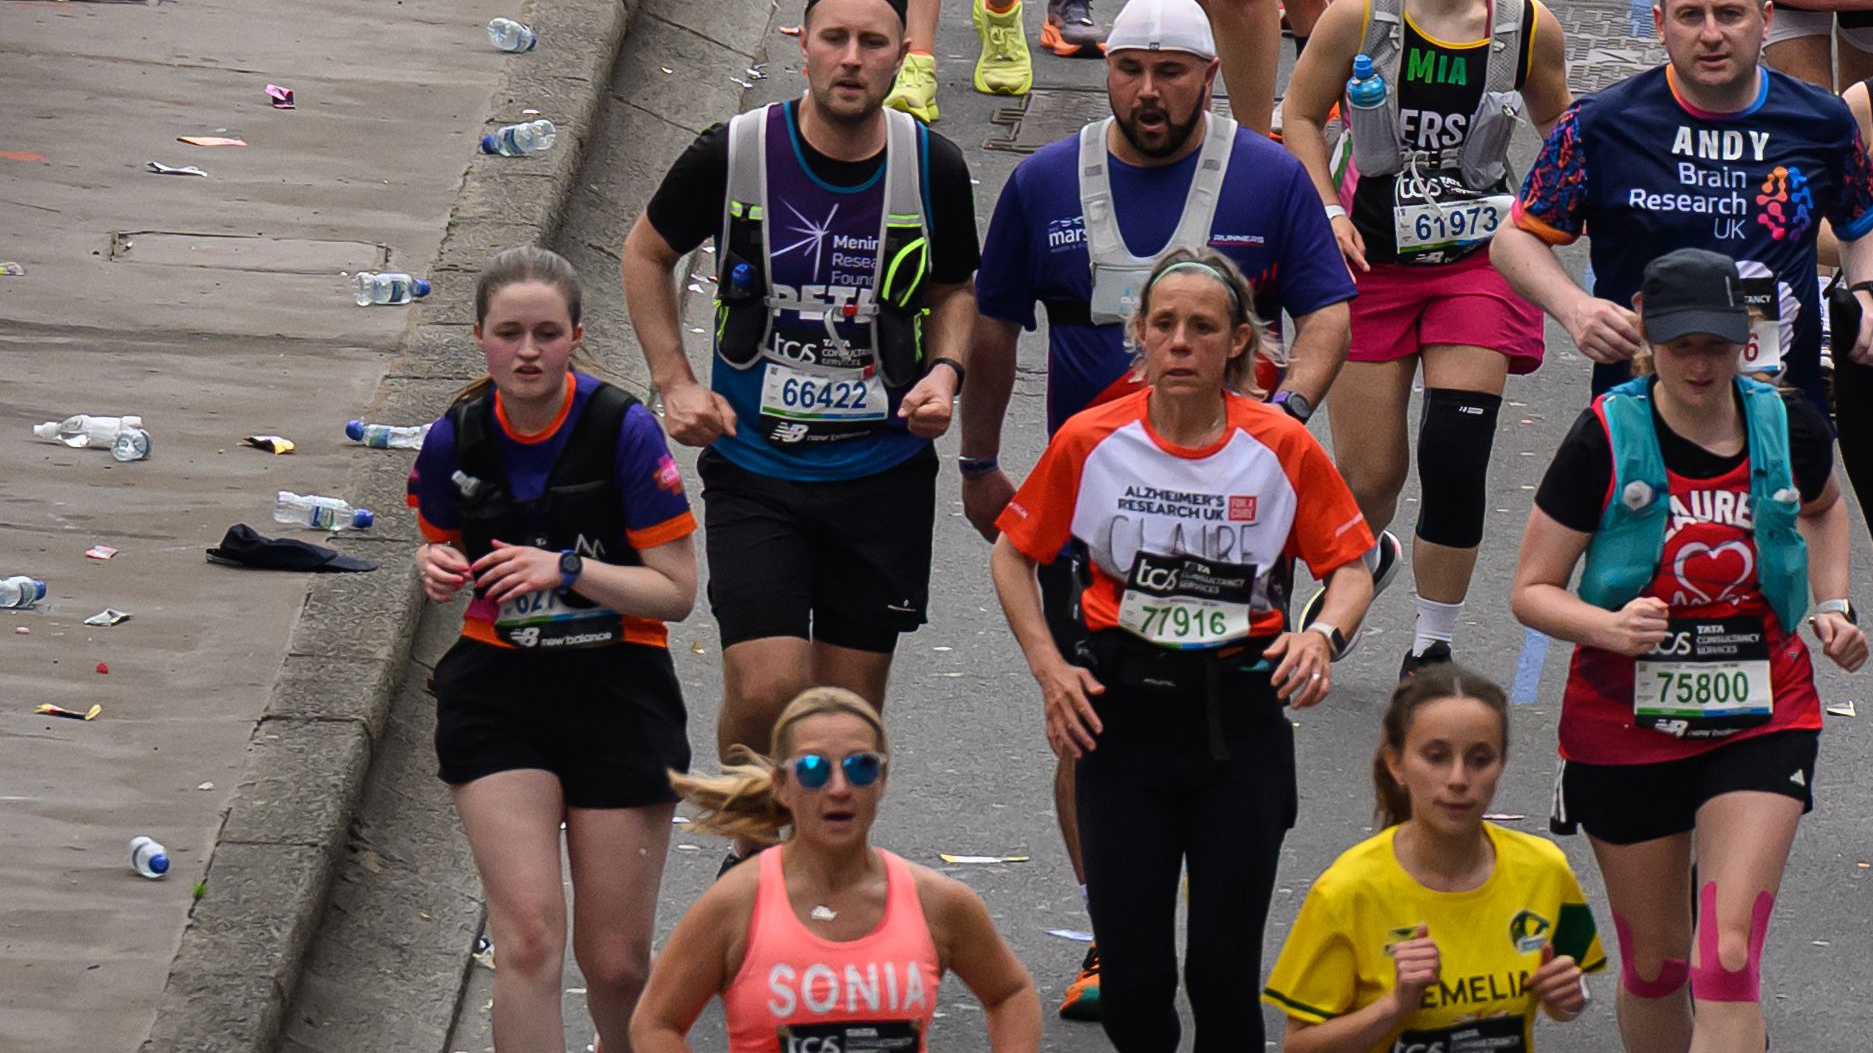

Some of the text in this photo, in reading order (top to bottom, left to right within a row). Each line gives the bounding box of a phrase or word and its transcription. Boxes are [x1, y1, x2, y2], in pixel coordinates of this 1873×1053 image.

[1406, 47, 1468, 87] MIA
[1672, 125, 1771, 162] ANDY
[1679, 162, 1747, 189] Brain
[1629, 188, 1748, 216] Research
[1414, 205, 1499, 241] 61973
[1714, 218, 1746, 240] UK
[774, 332, 816, 364] tcs
[782, 377, 867, 410] 66422
[1117, 497, 1200, 519] RESEARCH
[1202, 507, 1224, 521] UK
[1125, 485, 1225, 509] ALZHEIMER'S
[1135, 556, 1178, 592] tcs
[564, 630, 612, 646] balance
[1696, 625, 1725, 635] TATA
[1656, 671, 1749, 705] 75800
[768, 960, 926, 1020] SONIA
